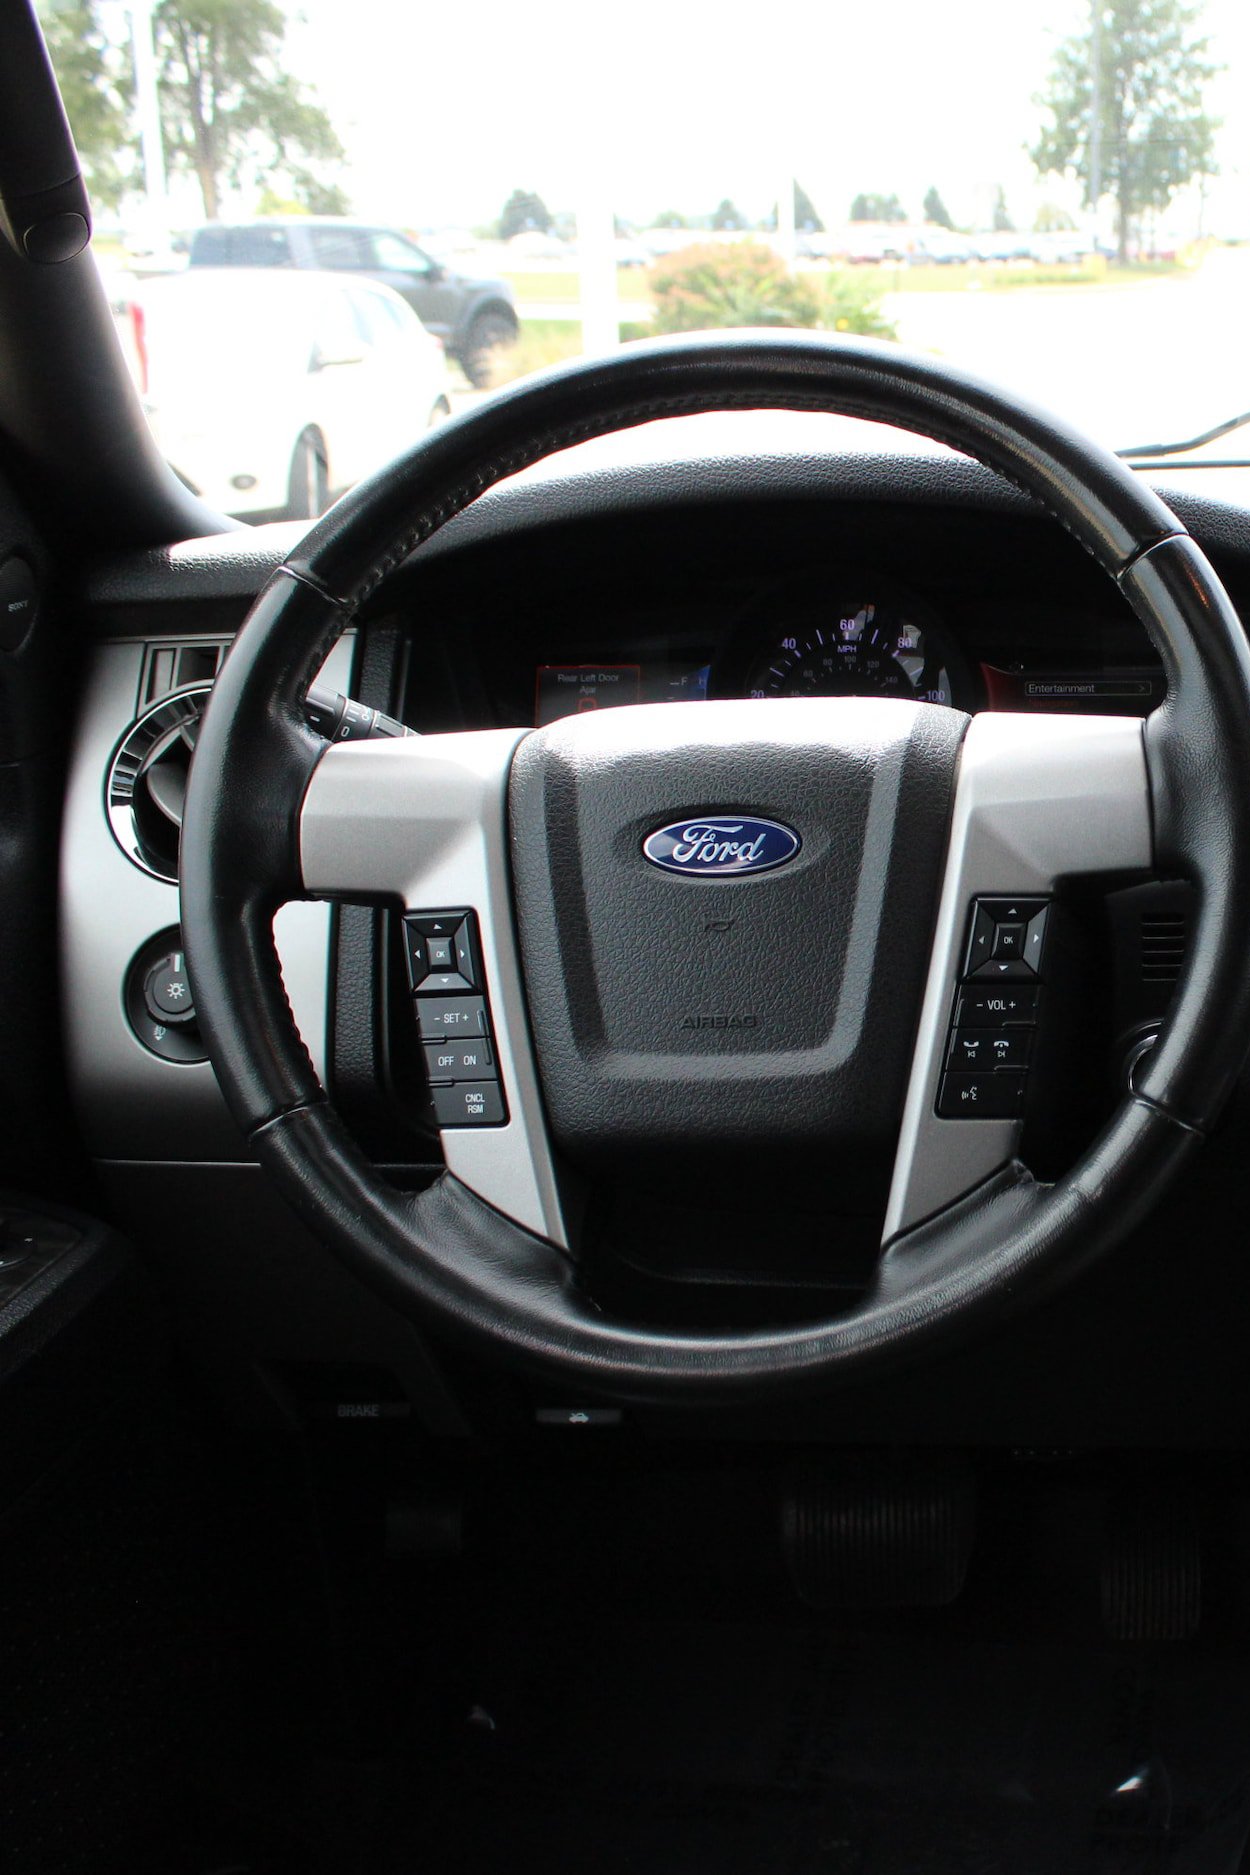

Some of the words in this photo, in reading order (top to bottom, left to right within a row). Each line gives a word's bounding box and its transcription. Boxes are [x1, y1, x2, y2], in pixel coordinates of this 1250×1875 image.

[839, 618, 855, 630] 60
[781, 638, 797, 650] 40
[897, 638, 912, 648] 80
[838, 645, 857, 654] MPH
[558, 674, 577, 682] Rear
[580, 673, 596, 682] Left
[598, 673, 619, 682] Door
[681, 678, 688, 686] F
[750, 690, 765, 698] 20
[1028, 684, 1095, 694] Entertainment
[927, 690, 946, 702] 100
[673, 824, 766, 862] Ford
[1004, 936, 1014, 944] OK
[988, 1000, 1006, 1010] VOL
[444, 1014, 460, 1024] SET
[681, 1015, 758, 1030] AIRBAG
[438, 1056, 454, 1066] OFF
[463, 1056, 476, 1066] ON
[465, 1094, 486, 1104] CNCL
[468, 1104, 484, 1114] RSM
[337, 1404, 380, 1418] BRAKE
